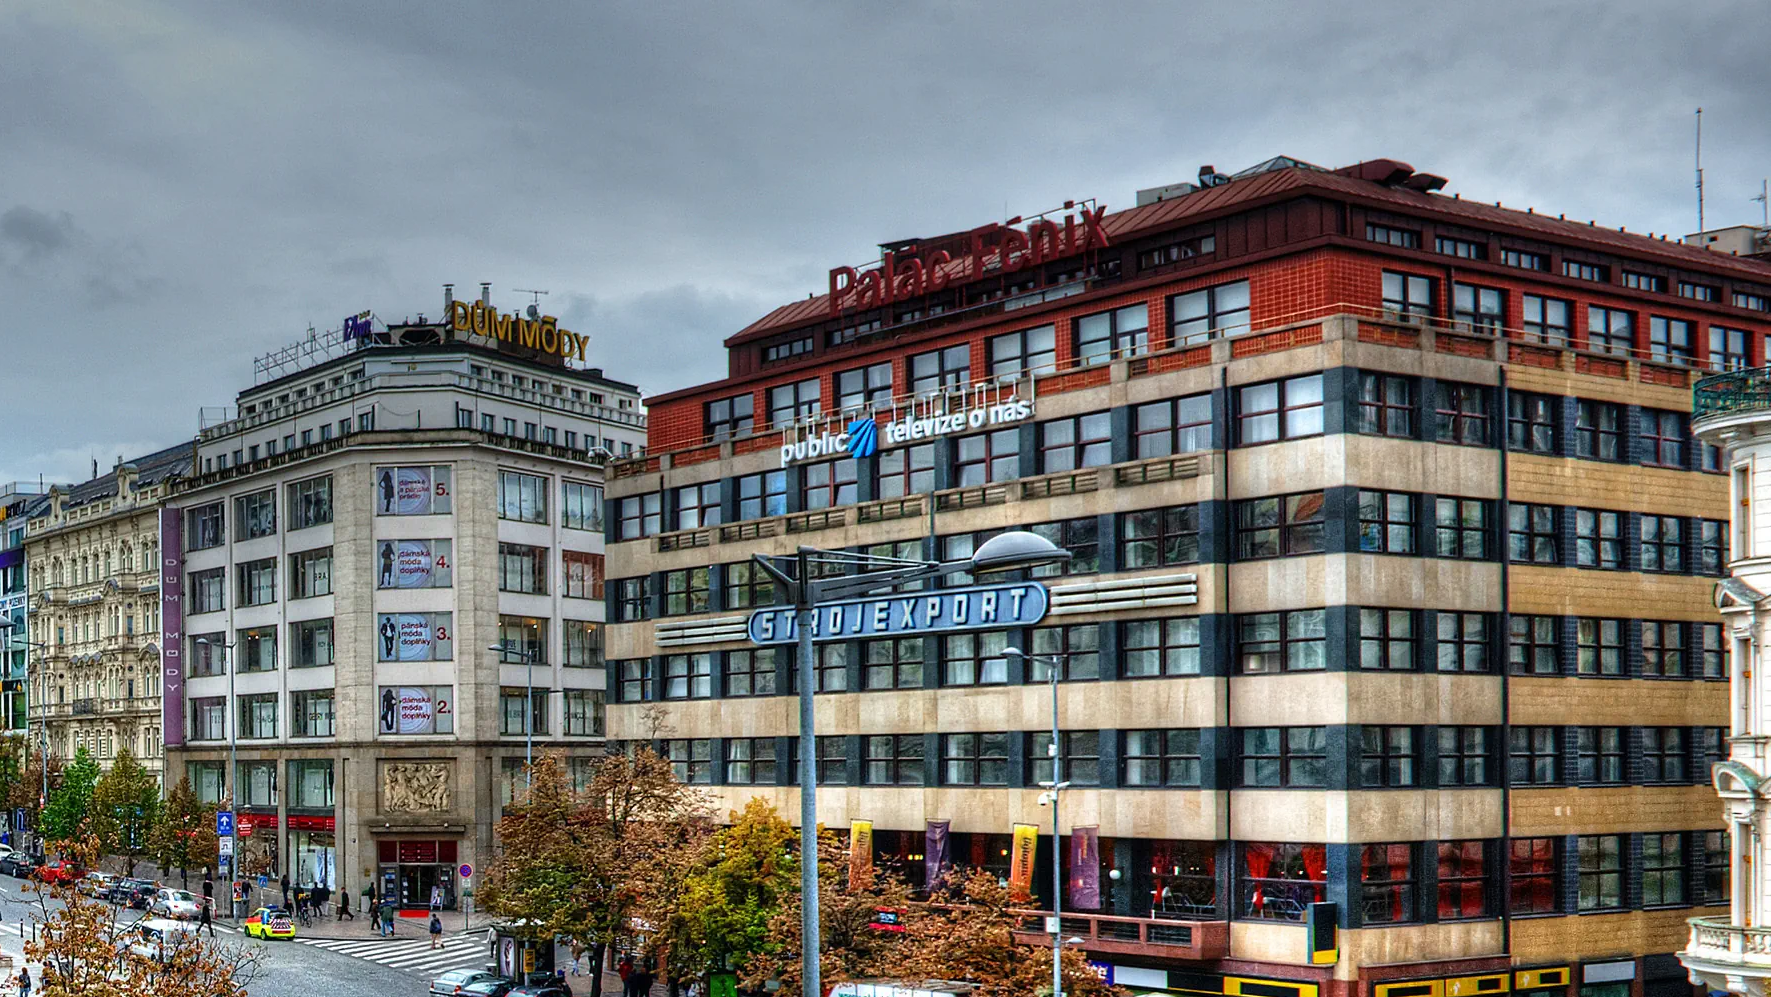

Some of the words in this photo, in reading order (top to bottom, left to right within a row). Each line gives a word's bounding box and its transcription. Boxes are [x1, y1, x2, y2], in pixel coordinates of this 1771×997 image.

[829, 244, 951, 317] Palác
[970, 200, 1108, 281] Fénix
[452, 300, 513, 343] DŮM
[780, 431, 851, 467] public
[885, 410, 967, 444] televize
[969, 408, 986, 428] o
[990, 396, 1031, 426] nás
[436, 483, 450, 496] 5.
[436, 555, 450, 569] 4.
[436, 626, 451, 640] 3.
[437, 700, 451, 714] 2.
